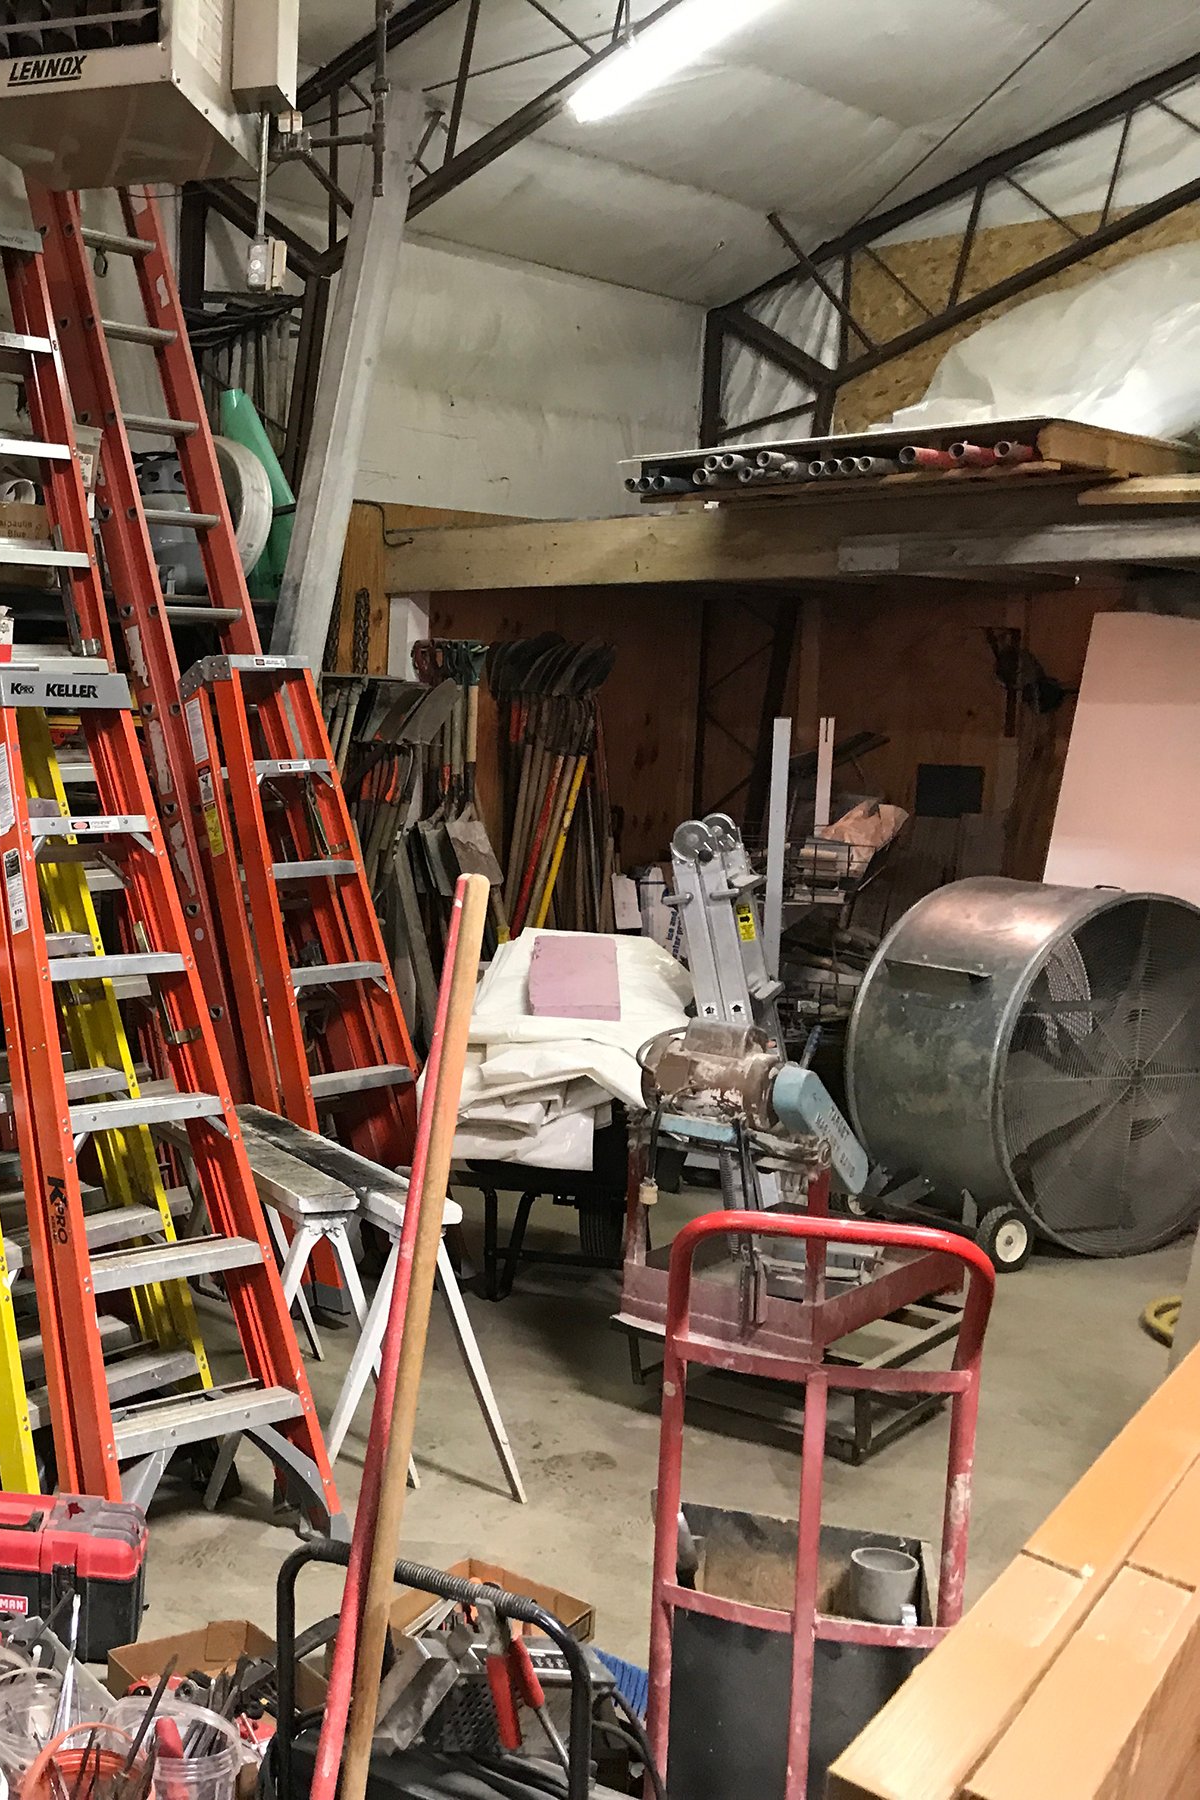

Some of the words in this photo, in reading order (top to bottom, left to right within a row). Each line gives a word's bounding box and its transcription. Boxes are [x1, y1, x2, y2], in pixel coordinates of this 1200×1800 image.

[8, 54, 88, 83] LENNOX
[10, 682, 35, 695] KPRO
[45, 683, 99, 699] KELLER
[47, 1175, 68, 1245] KPRO
